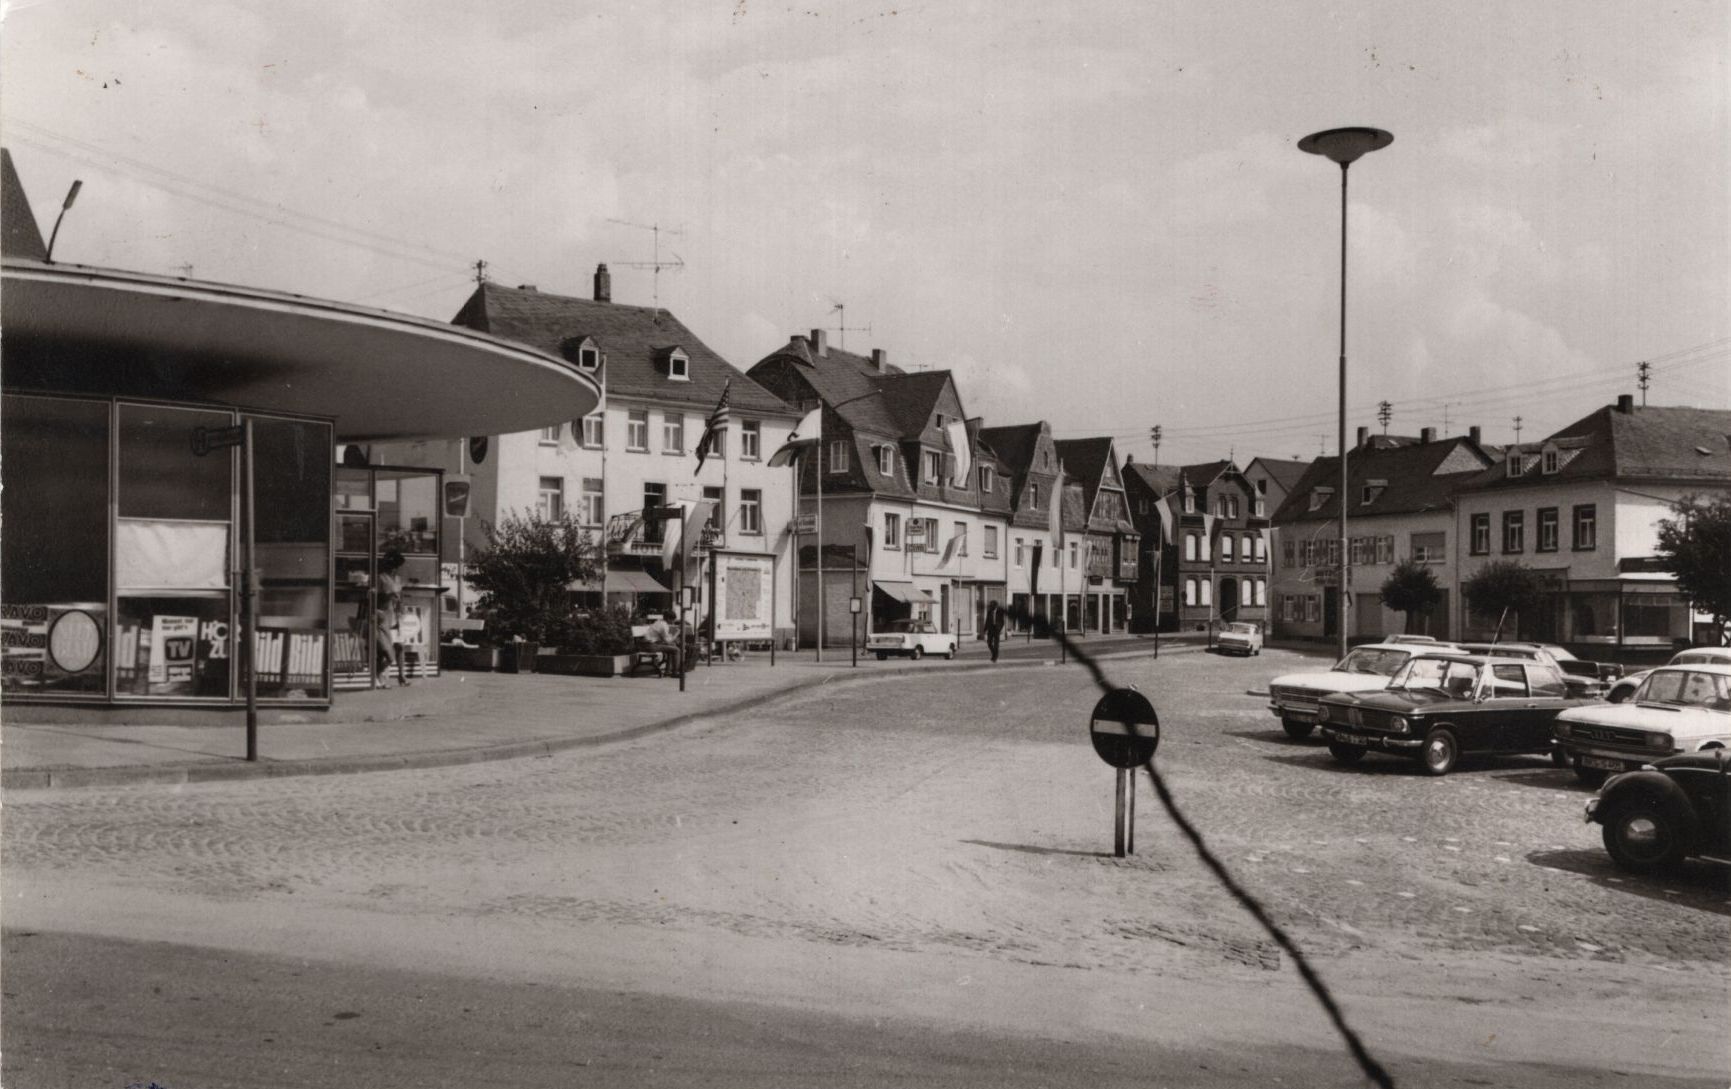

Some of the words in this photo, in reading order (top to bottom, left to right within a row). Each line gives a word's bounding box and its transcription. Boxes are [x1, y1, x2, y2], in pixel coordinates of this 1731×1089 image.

[631, 543, 663, 554] HOTE
[1, 605, 44, 619] RAVO
[166, 640, 191, 658] TV
[255, 631, 285, 674] ild
[287, 633, 325, 675] Bild
